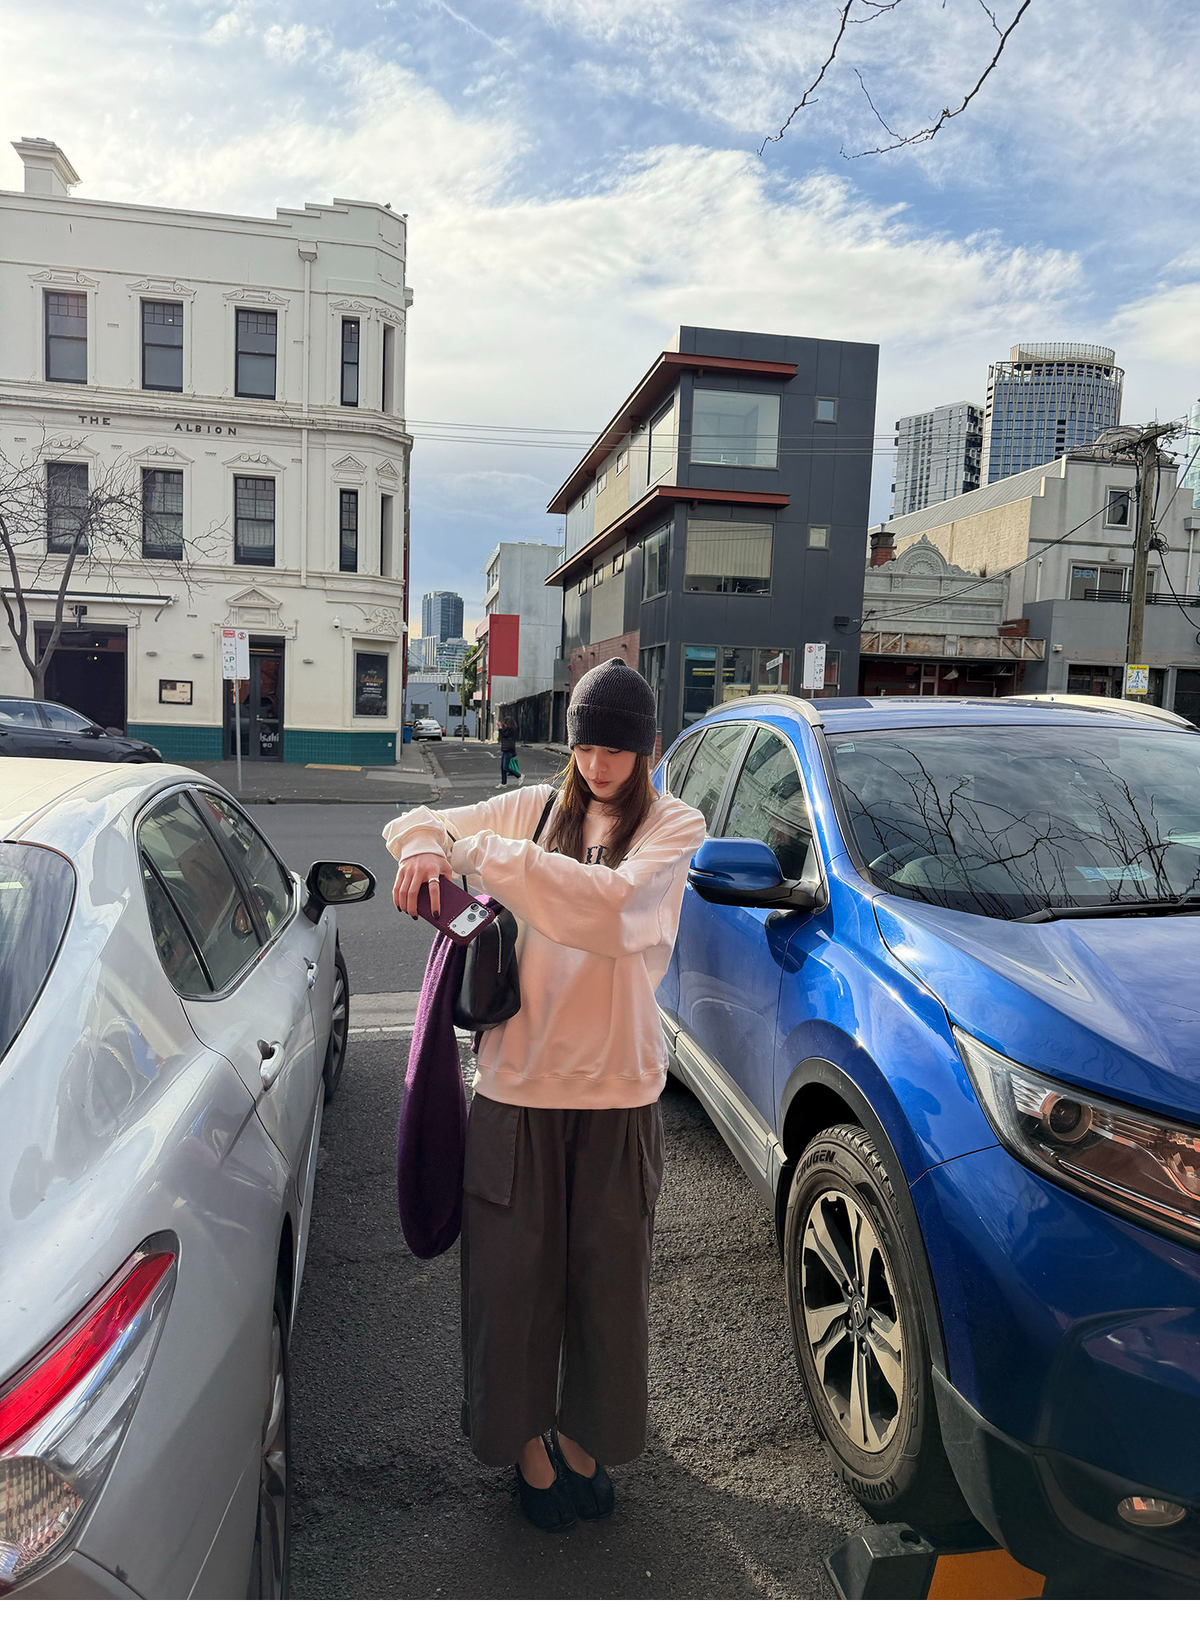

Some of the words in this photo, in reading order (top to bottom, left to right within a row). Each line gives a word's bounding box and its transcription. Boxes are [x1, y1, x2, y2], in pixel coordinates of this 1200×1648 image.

[78, 415, 111, 426] THE
[174, 423, 237, 436] ALBION
[851, 1475, 899, 1501] KUMHO
